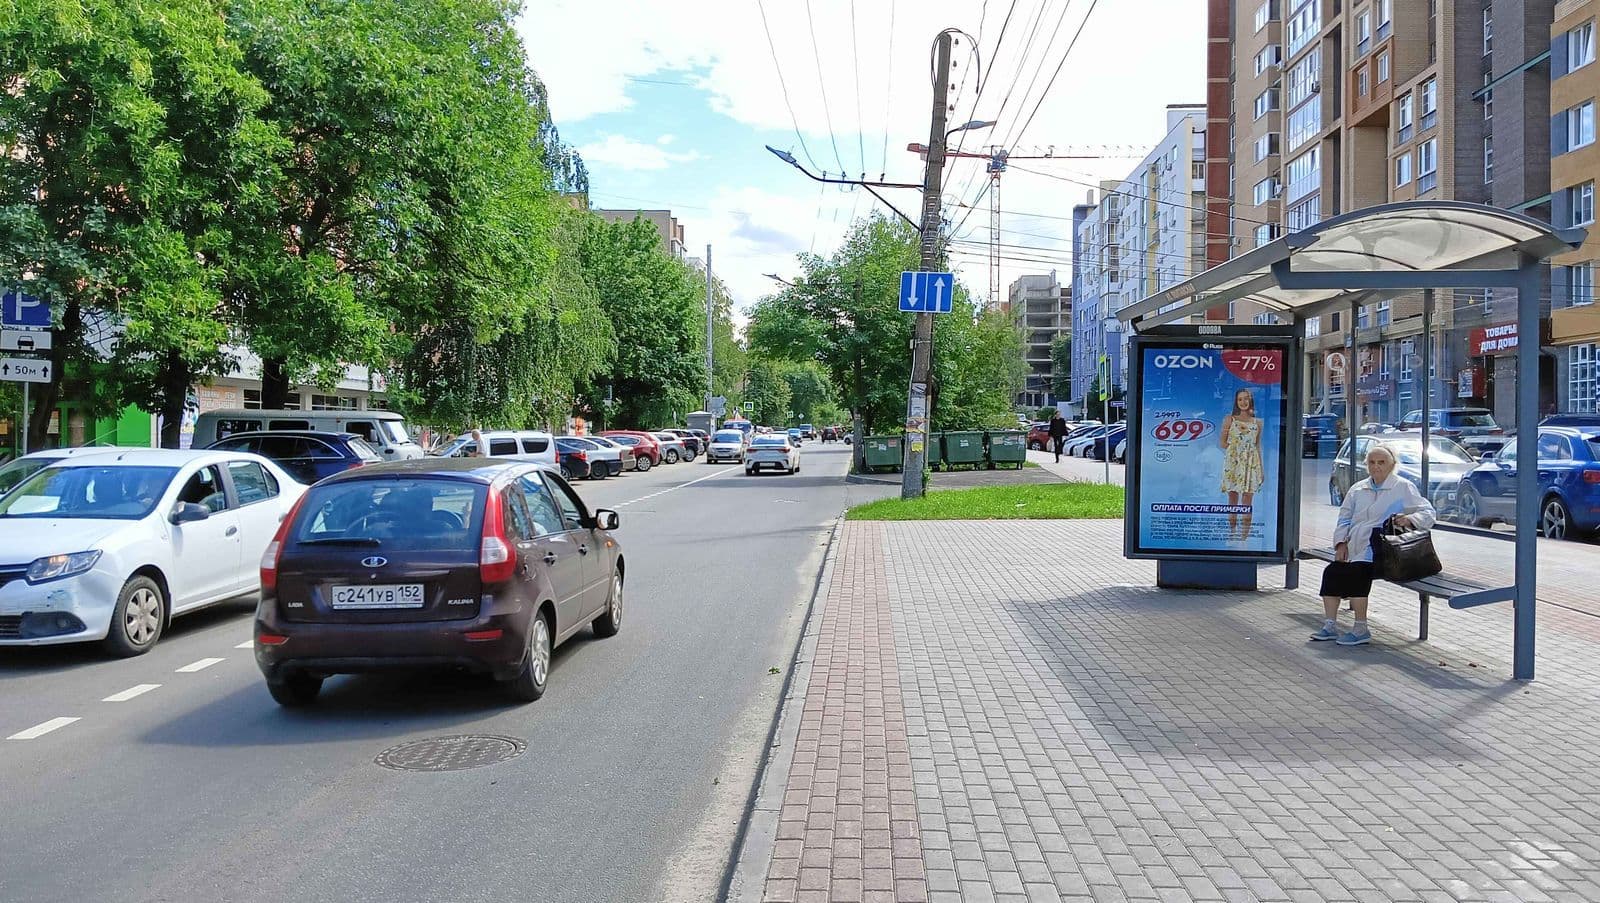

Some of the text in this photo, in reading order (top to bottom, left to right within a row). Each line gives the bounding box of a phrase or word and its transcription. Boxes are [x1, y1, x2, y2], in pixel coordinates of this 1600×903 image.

[1479, 340, 1497, 354] ДЛЯ
[1154, 355, 1213, 369] OZON
[1155, 420, 1204, 441] 699
[1152, 504, 1182, 512] ОПЛАТА
[1210, 505, 1251, 513] ПРИМЕРКИ
[398, 586, 420, 598] 152
